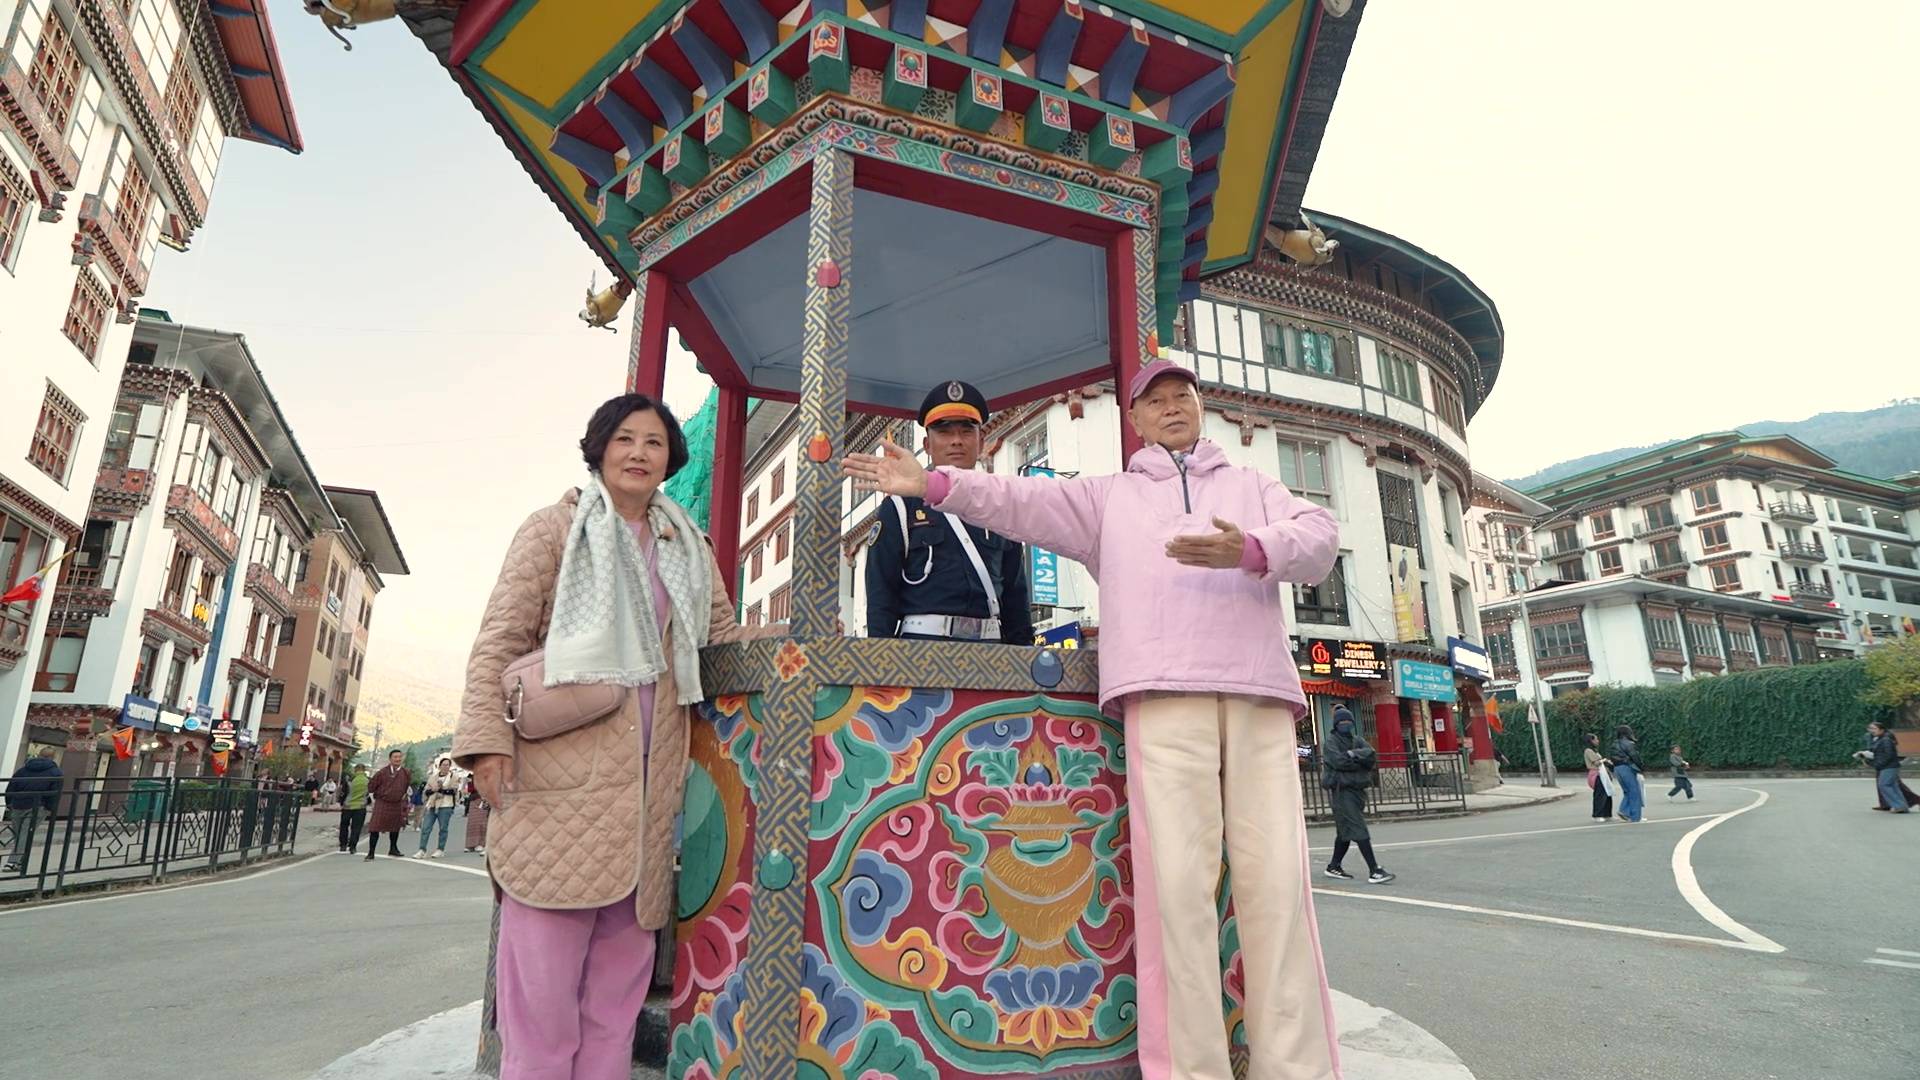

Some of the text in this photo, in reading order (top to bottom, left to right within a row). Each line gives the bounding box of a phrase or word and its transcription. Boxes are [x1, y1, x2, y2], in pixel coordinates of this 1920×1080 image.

[1344, 649, 1375, 659] DINESH
[1334, 658, 1379, 669] JEWELLERY
[1380, 661, 1386, 670] 2
